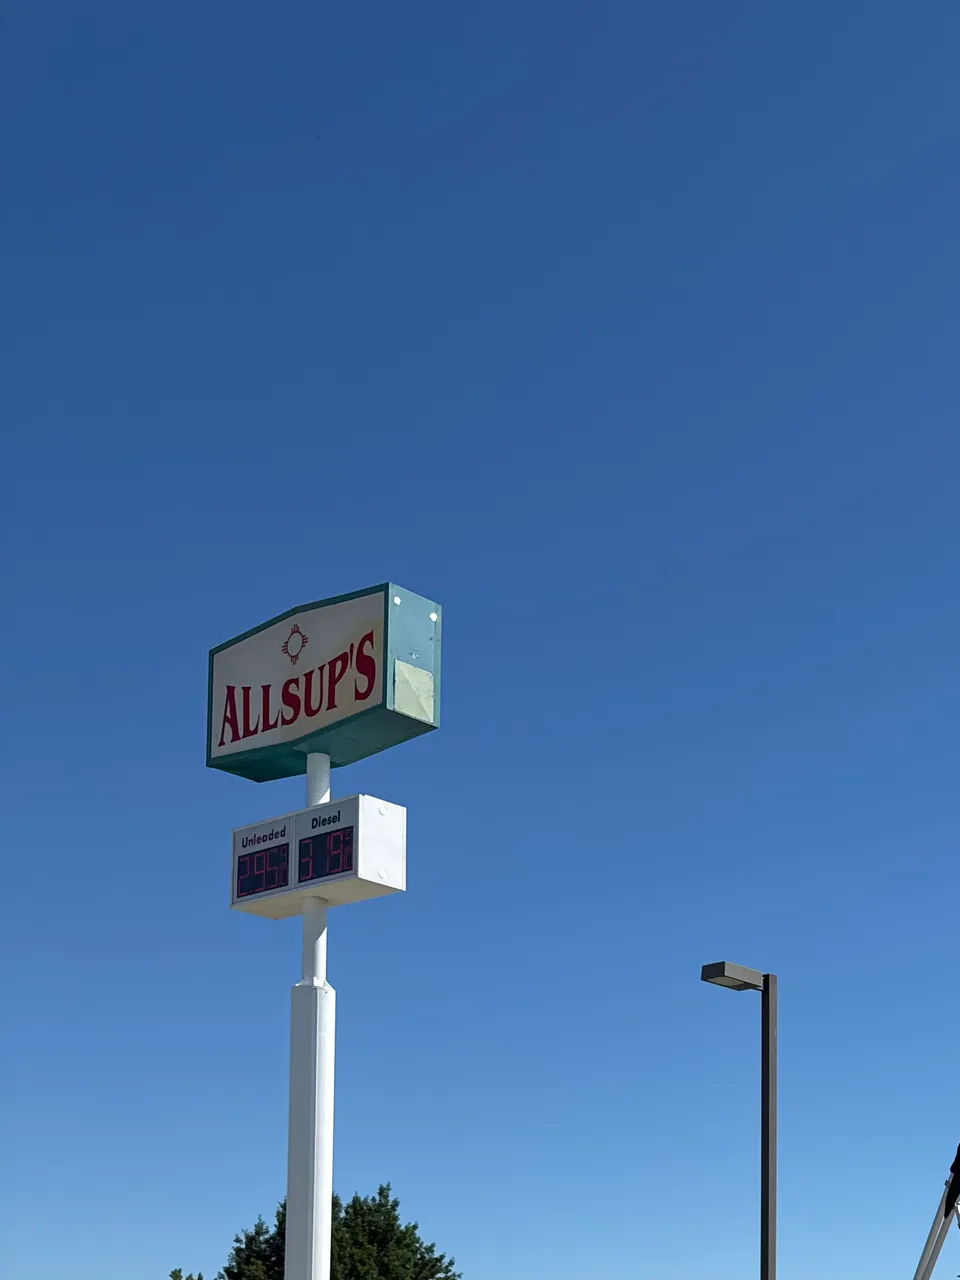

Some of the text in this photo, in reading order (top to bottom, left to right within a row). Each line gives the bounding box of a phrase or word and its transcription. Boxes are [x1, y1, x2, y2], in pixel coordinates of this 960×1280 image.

[218, 629, 377, 748] ALLSUP'S
[311, 810, 341, 829] Diesel
[242, 825, 286, 848] Unleaded
